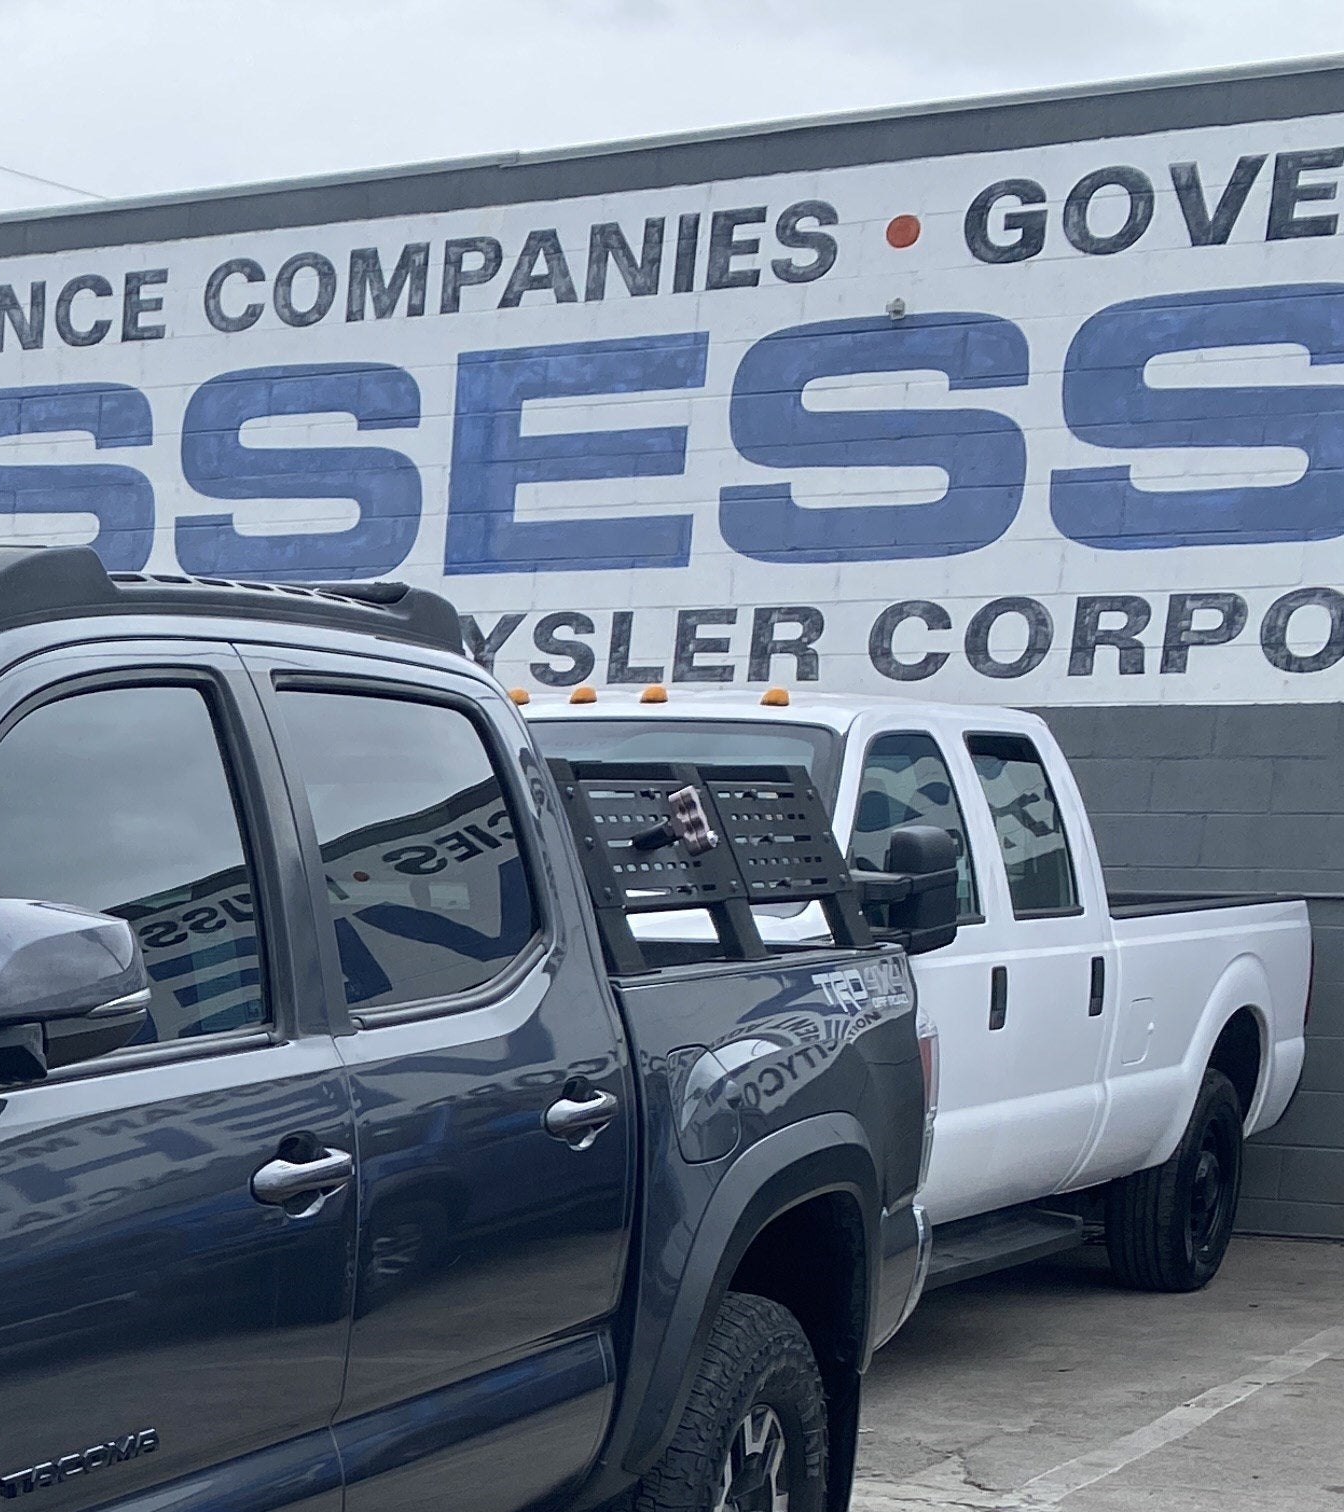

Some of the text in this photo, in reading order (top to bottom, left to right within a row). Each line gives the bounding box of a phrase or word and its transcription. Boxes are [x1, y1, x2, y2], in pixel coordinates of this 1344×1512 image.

[204, 200, 839, 332] COMPANIES
[963, 146, 1344, 264] GOVE
[868, 587, 1344, 682] CORPO
[811, 968, 870, 1013] TRD
